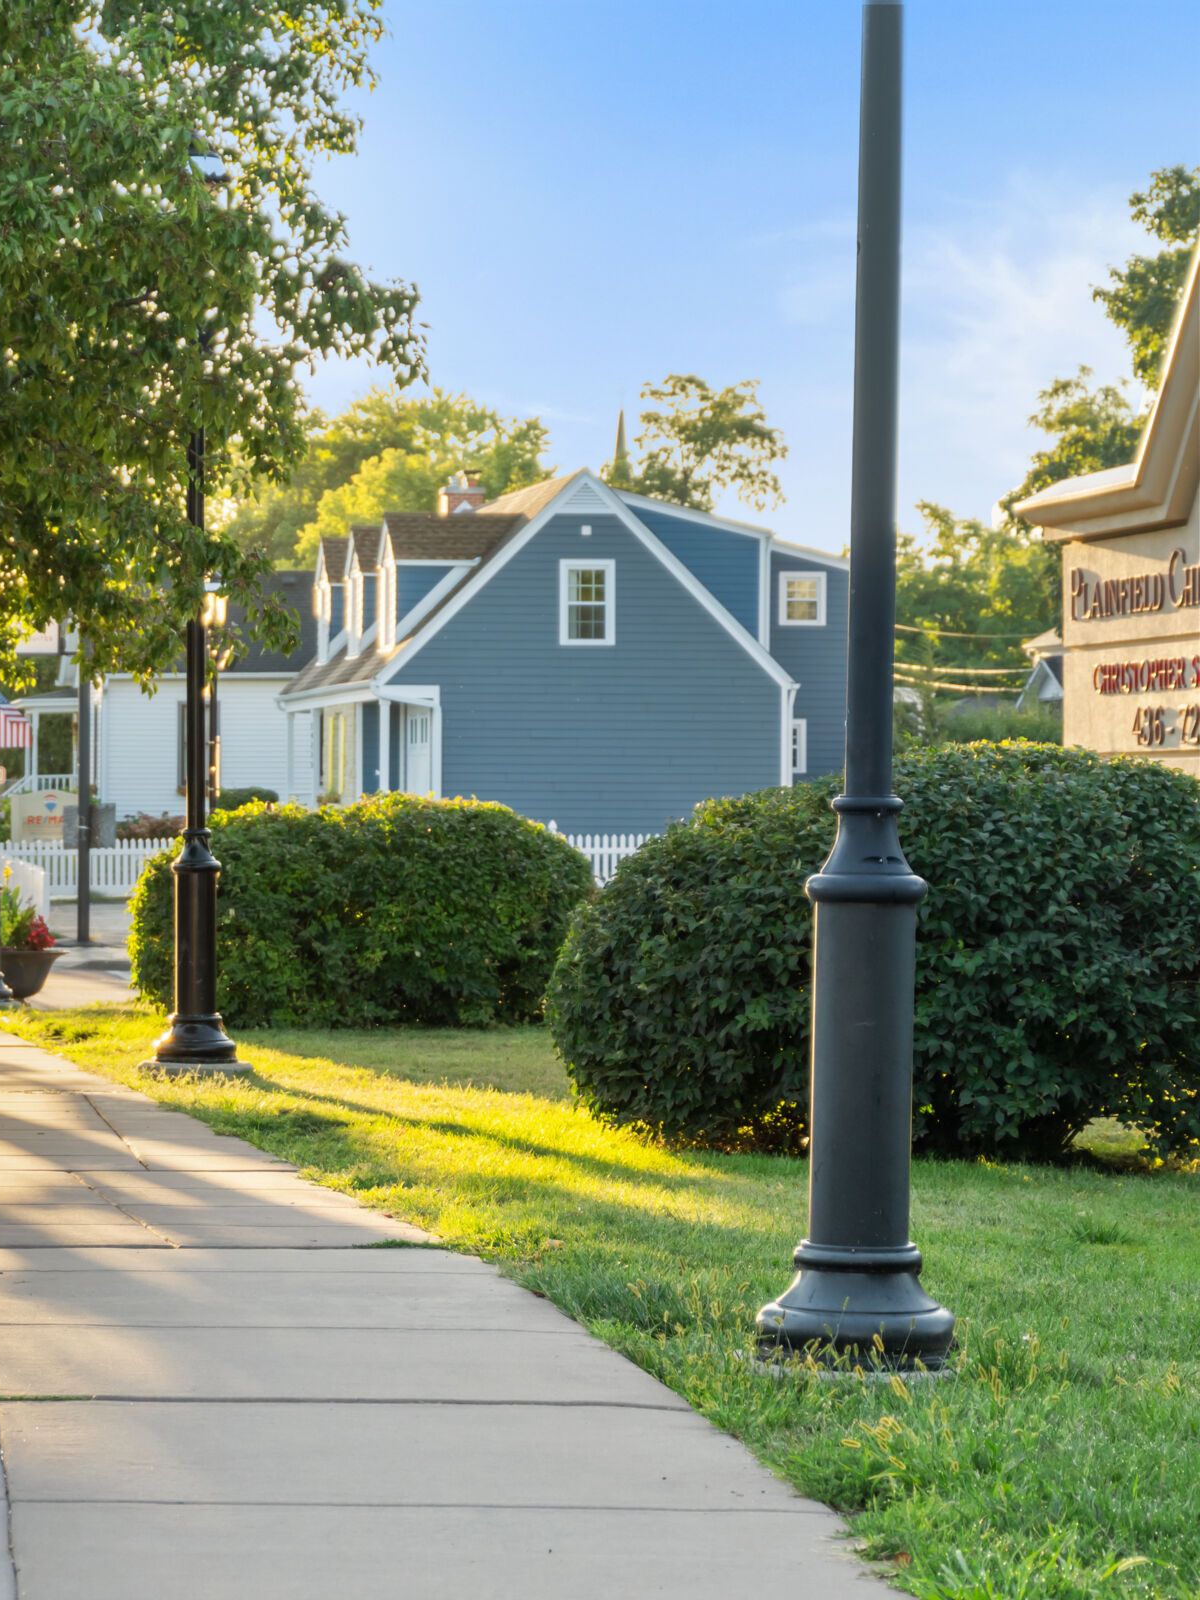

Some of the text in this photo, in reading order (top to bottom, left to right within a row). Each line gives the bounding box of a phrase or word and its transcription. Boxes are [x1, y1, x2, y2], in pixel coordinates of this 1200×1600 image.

[1071, 567, 1166, 621] PLAINFIELD
[1093, 656, 1187, 695] CHRISTOPHER
[26, 815, 64, 825] RE/MA
